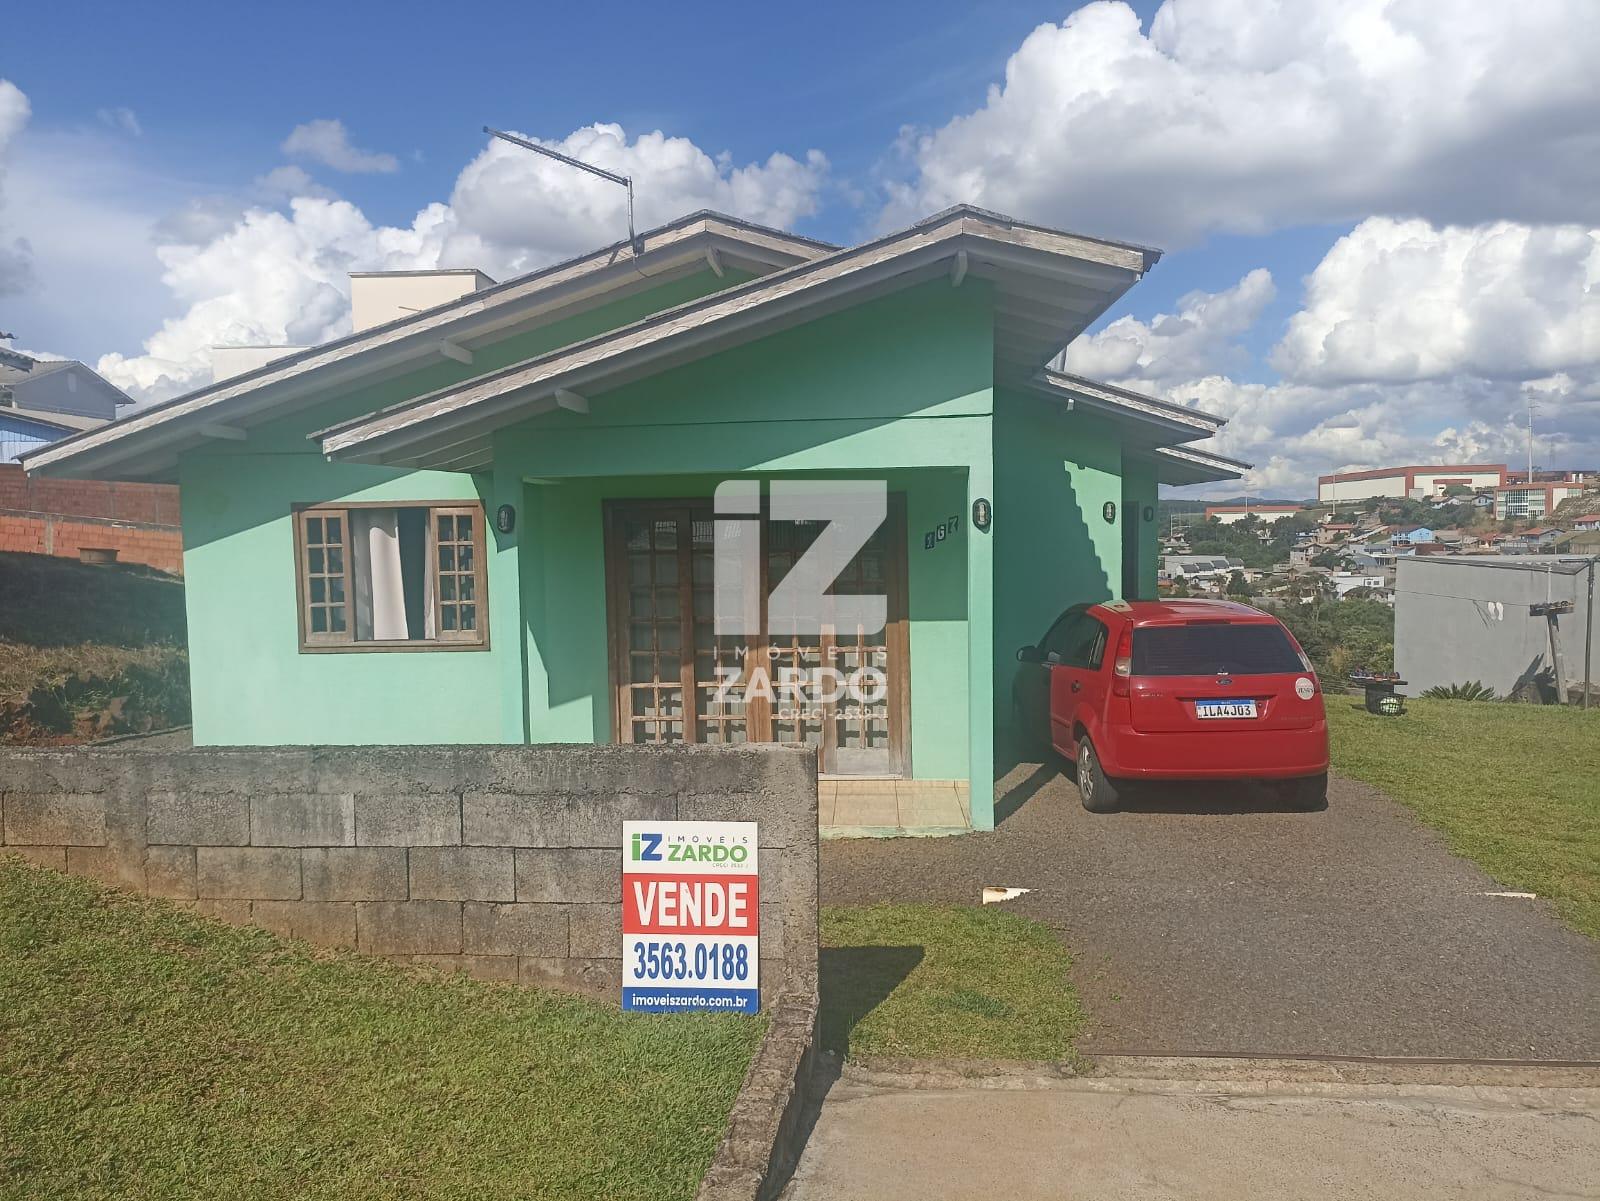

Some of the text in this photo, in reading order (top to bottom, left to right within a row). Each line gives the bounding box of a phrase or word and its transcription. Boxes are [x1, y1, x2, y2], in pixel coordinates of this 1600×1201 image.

[667, 845, 749, 862] ZARDO
[633, 881, 748, 928] VENDE
[633, 942, 749, 980] 3563.0188
[632, 993, 748, 1008] imoveiszardo.com.br
